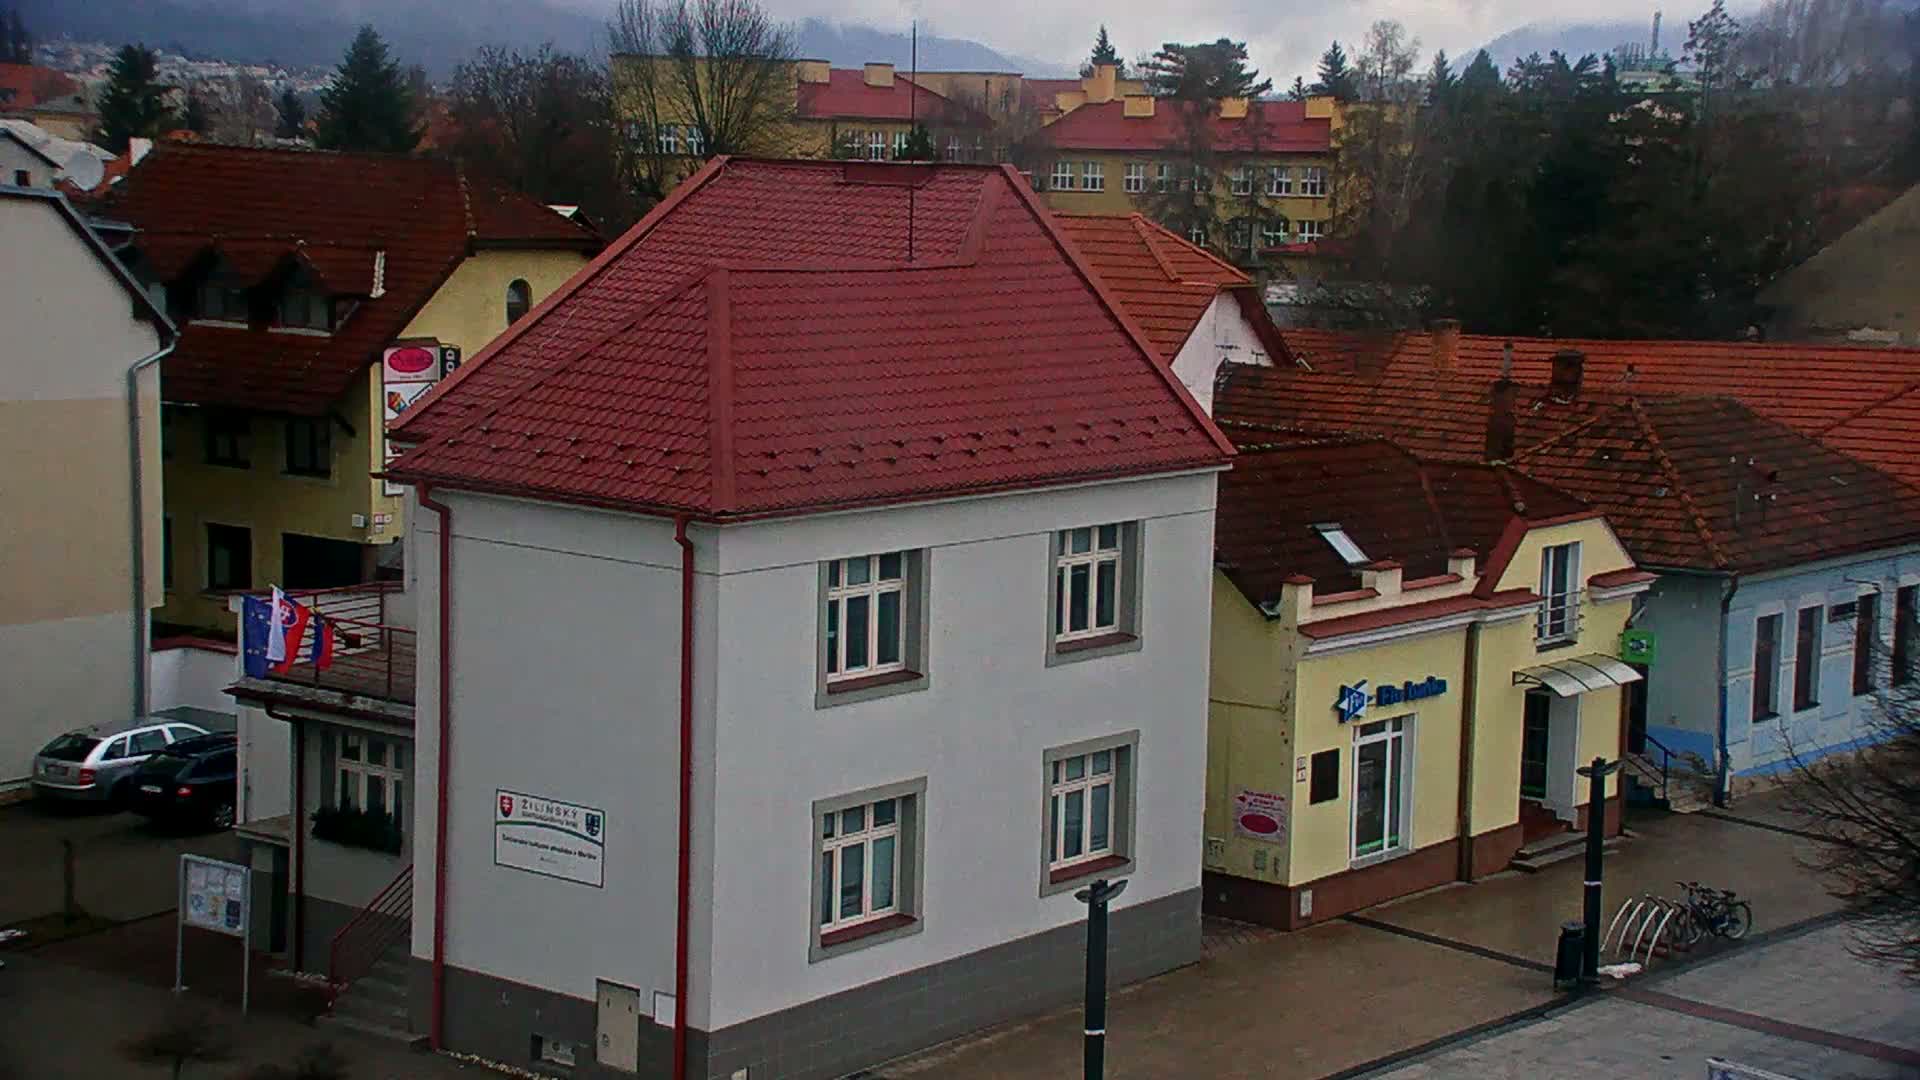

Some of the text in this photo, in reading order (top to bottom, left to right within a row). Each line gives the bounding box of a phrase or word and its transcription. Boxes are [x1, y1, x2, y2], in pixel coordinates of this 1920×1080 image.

[1376, 675, 1447, 706] Fio banka
[520, 797, 578, 818] ŽILINSKÝ
